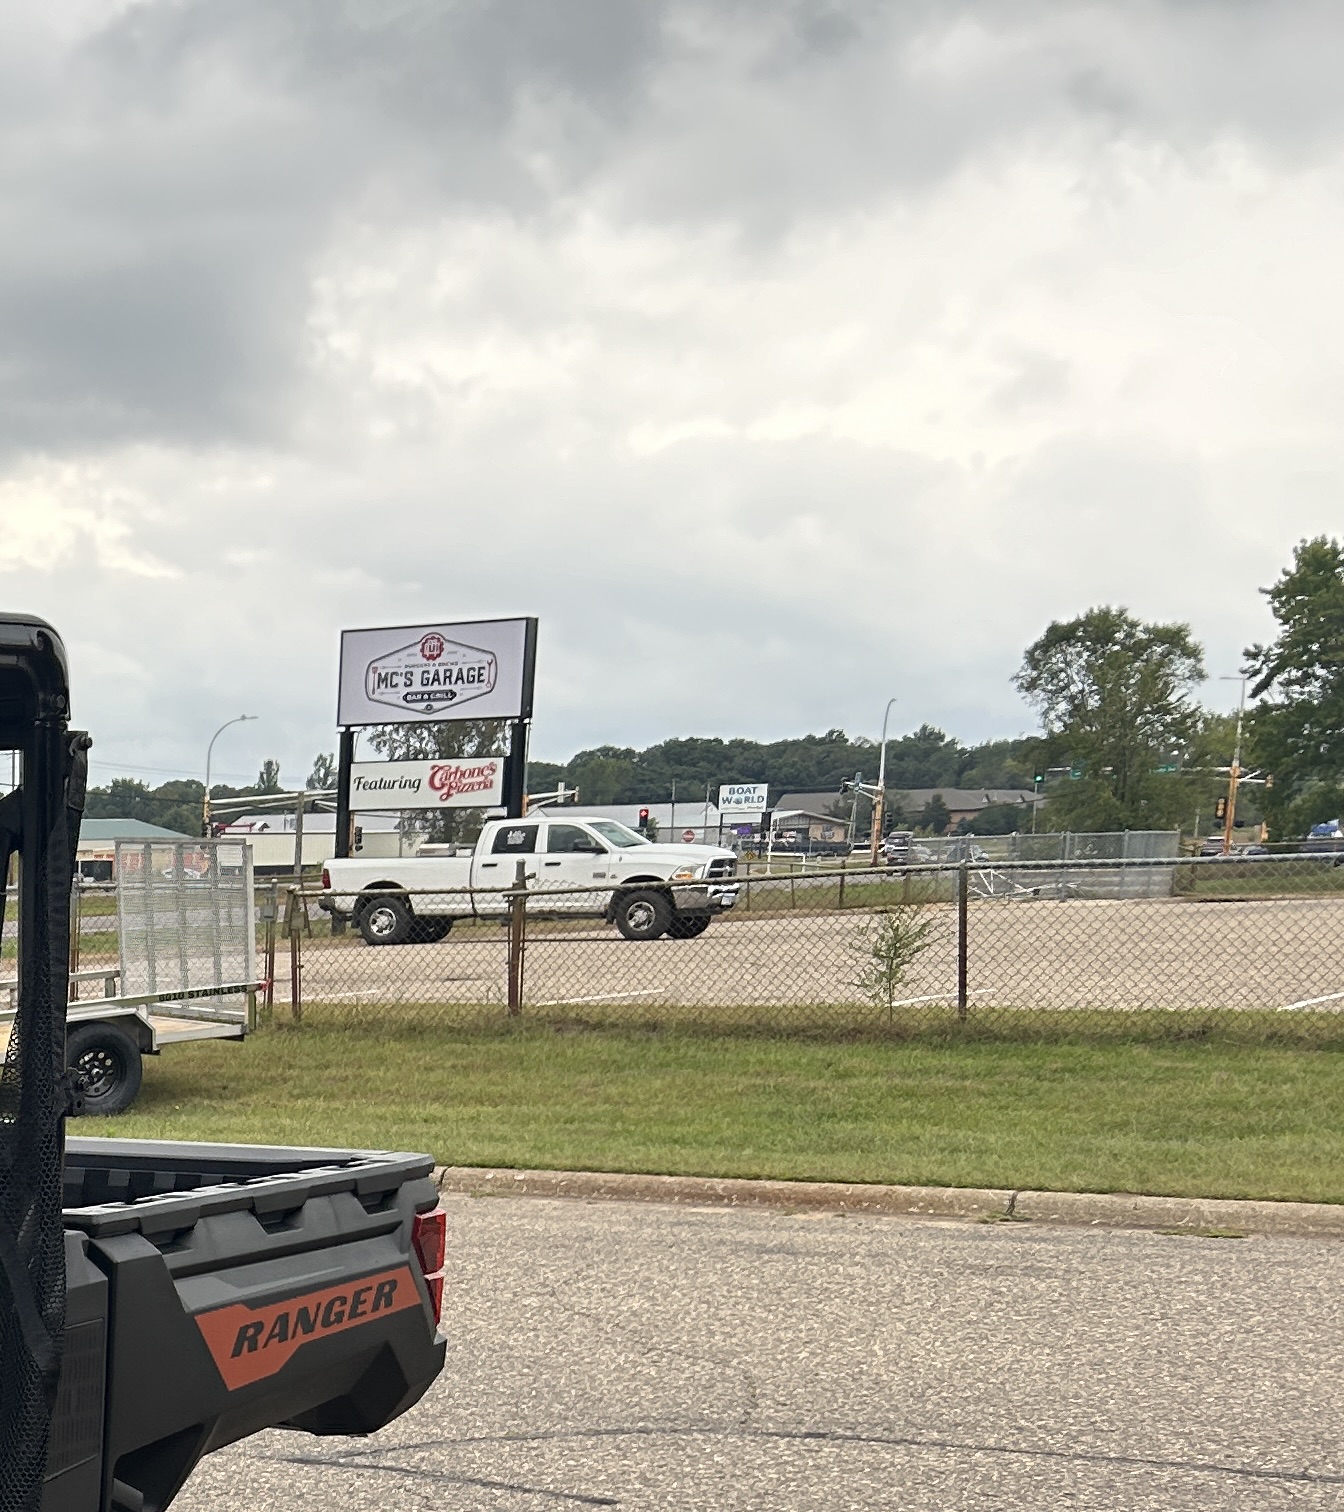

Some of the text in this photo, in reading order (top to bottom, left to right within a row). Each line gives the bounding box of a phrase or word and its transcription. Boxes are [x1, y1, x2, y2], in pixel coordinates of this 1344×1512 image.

[376, 666, 486, 689] MC'S GARAGE
[353, 775, 422, 793] Featuring
[728, 786, 758, 795] BOAT
[187, 984, 248, 999] STAINLESS
[228, 1278, 399, 1359] RANGER
